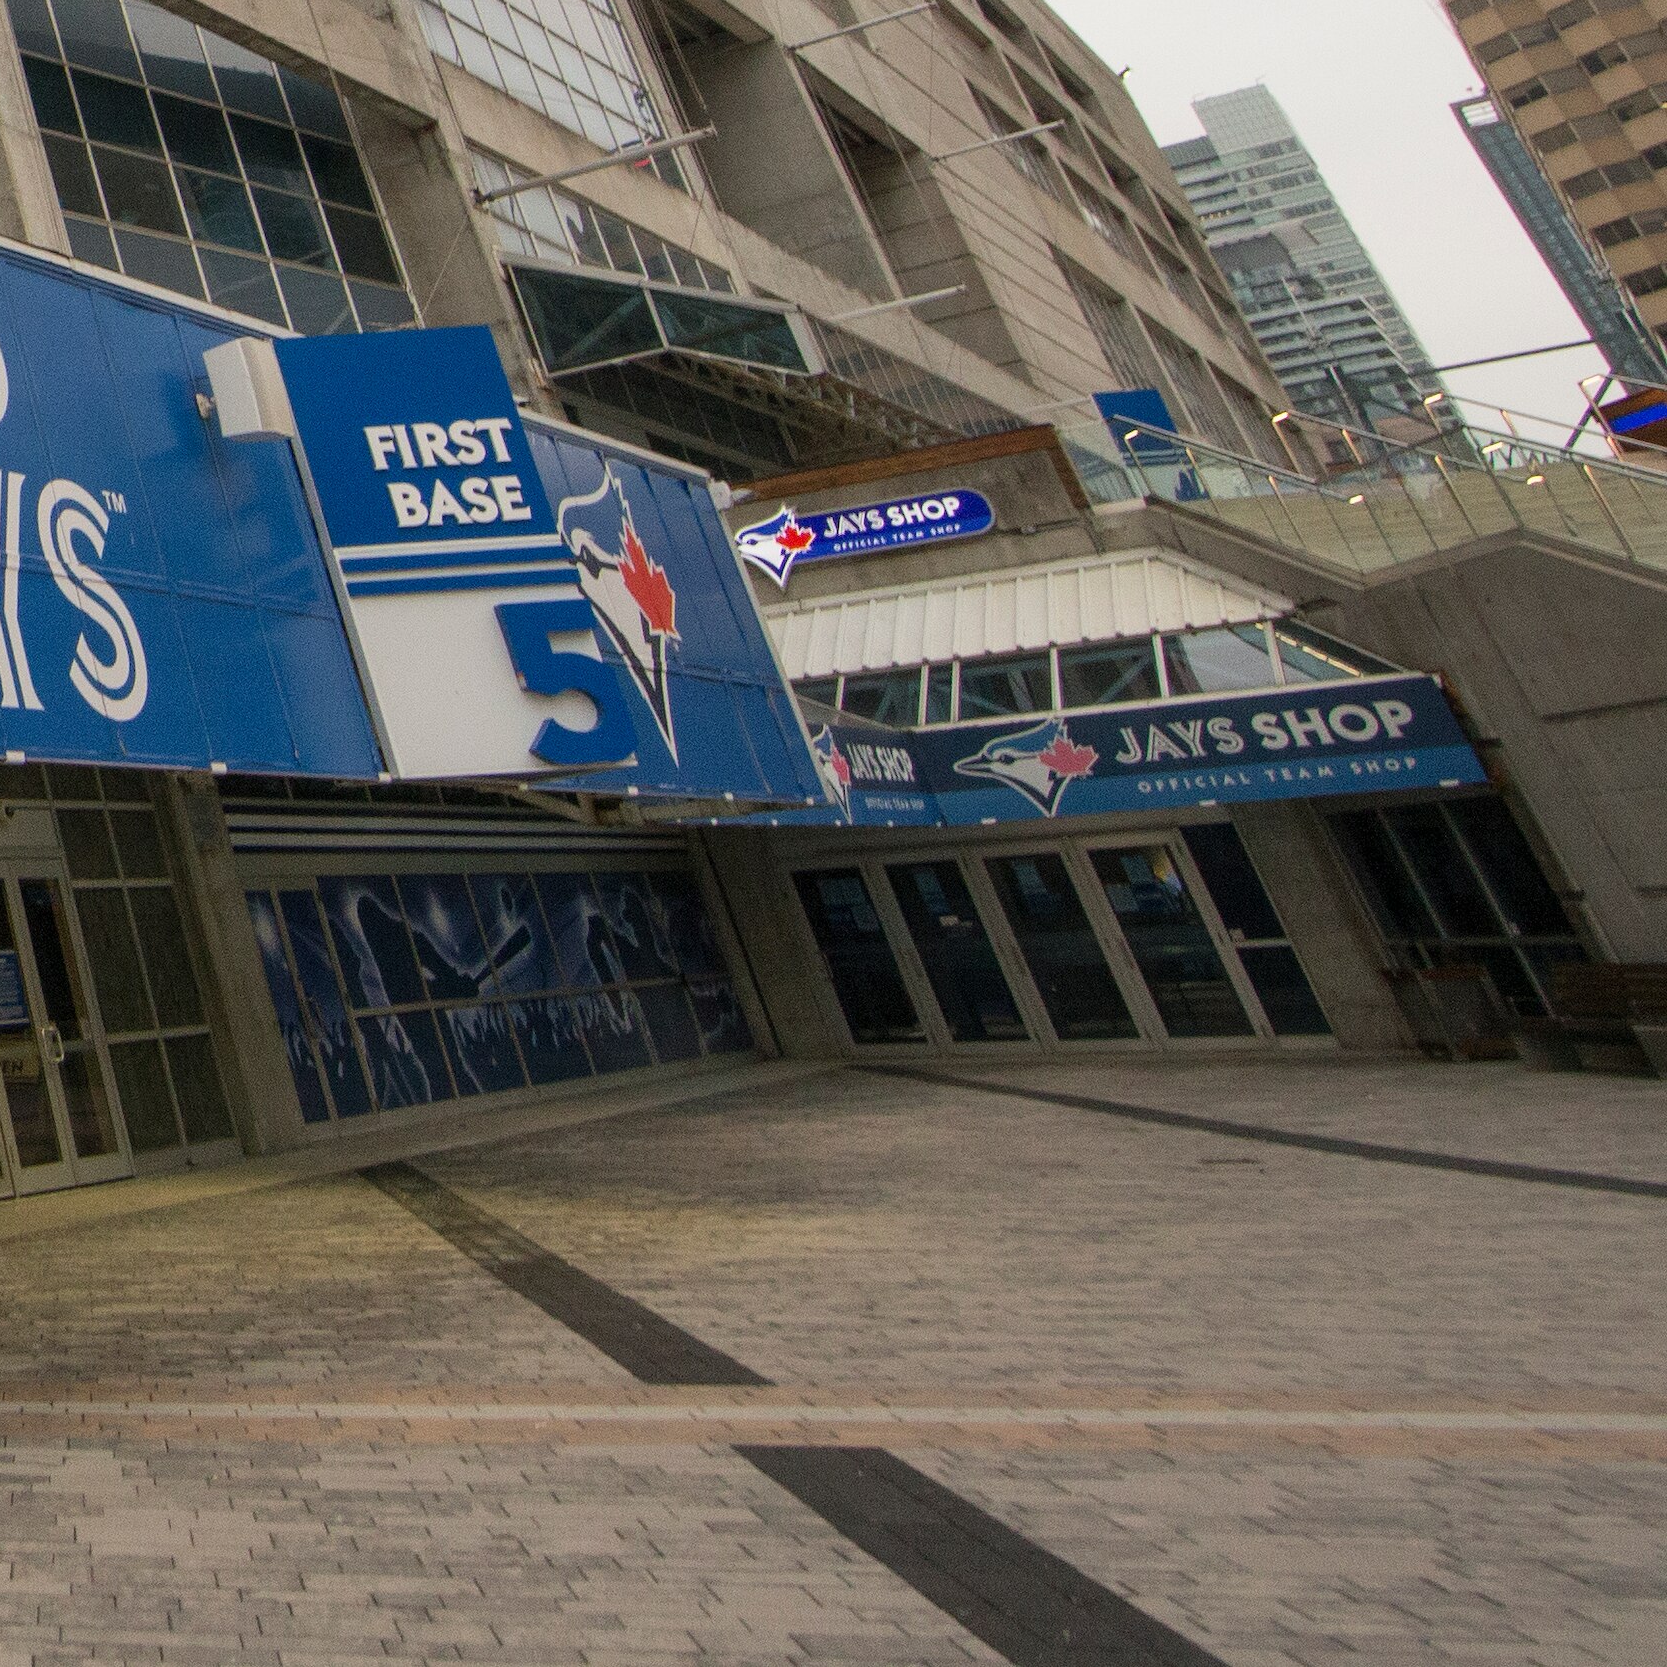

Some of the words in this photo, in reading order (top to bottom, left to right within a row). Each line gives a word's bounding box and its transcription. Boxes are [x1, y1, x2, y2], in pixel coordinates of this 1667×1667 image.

[363, 418, 512, 471] FIRST
[387, 475, 532, 528] BASE
[823, 509, 884, 539] JAYS
[886, 495, 960, 528] SHOP
[833, 536, 887, 553] OFFICIAL
[892, 531, 925, 542] TEAM
[930, 524, 961, 537] SHOP
[493, 599, 639, 766] 5
[1115, 717, 1245, 764] JAYS
[1251, 699, 1414, 751] SHOP
[847, 743, 882, 780] JAYS
[876, 745, 915, 782] SHOP
[1138, 771, 1251, 794] OFFICIAL
[1264, 764, 1335, 783] TEAM
[1349, 756, 1417, 776] SHOP
